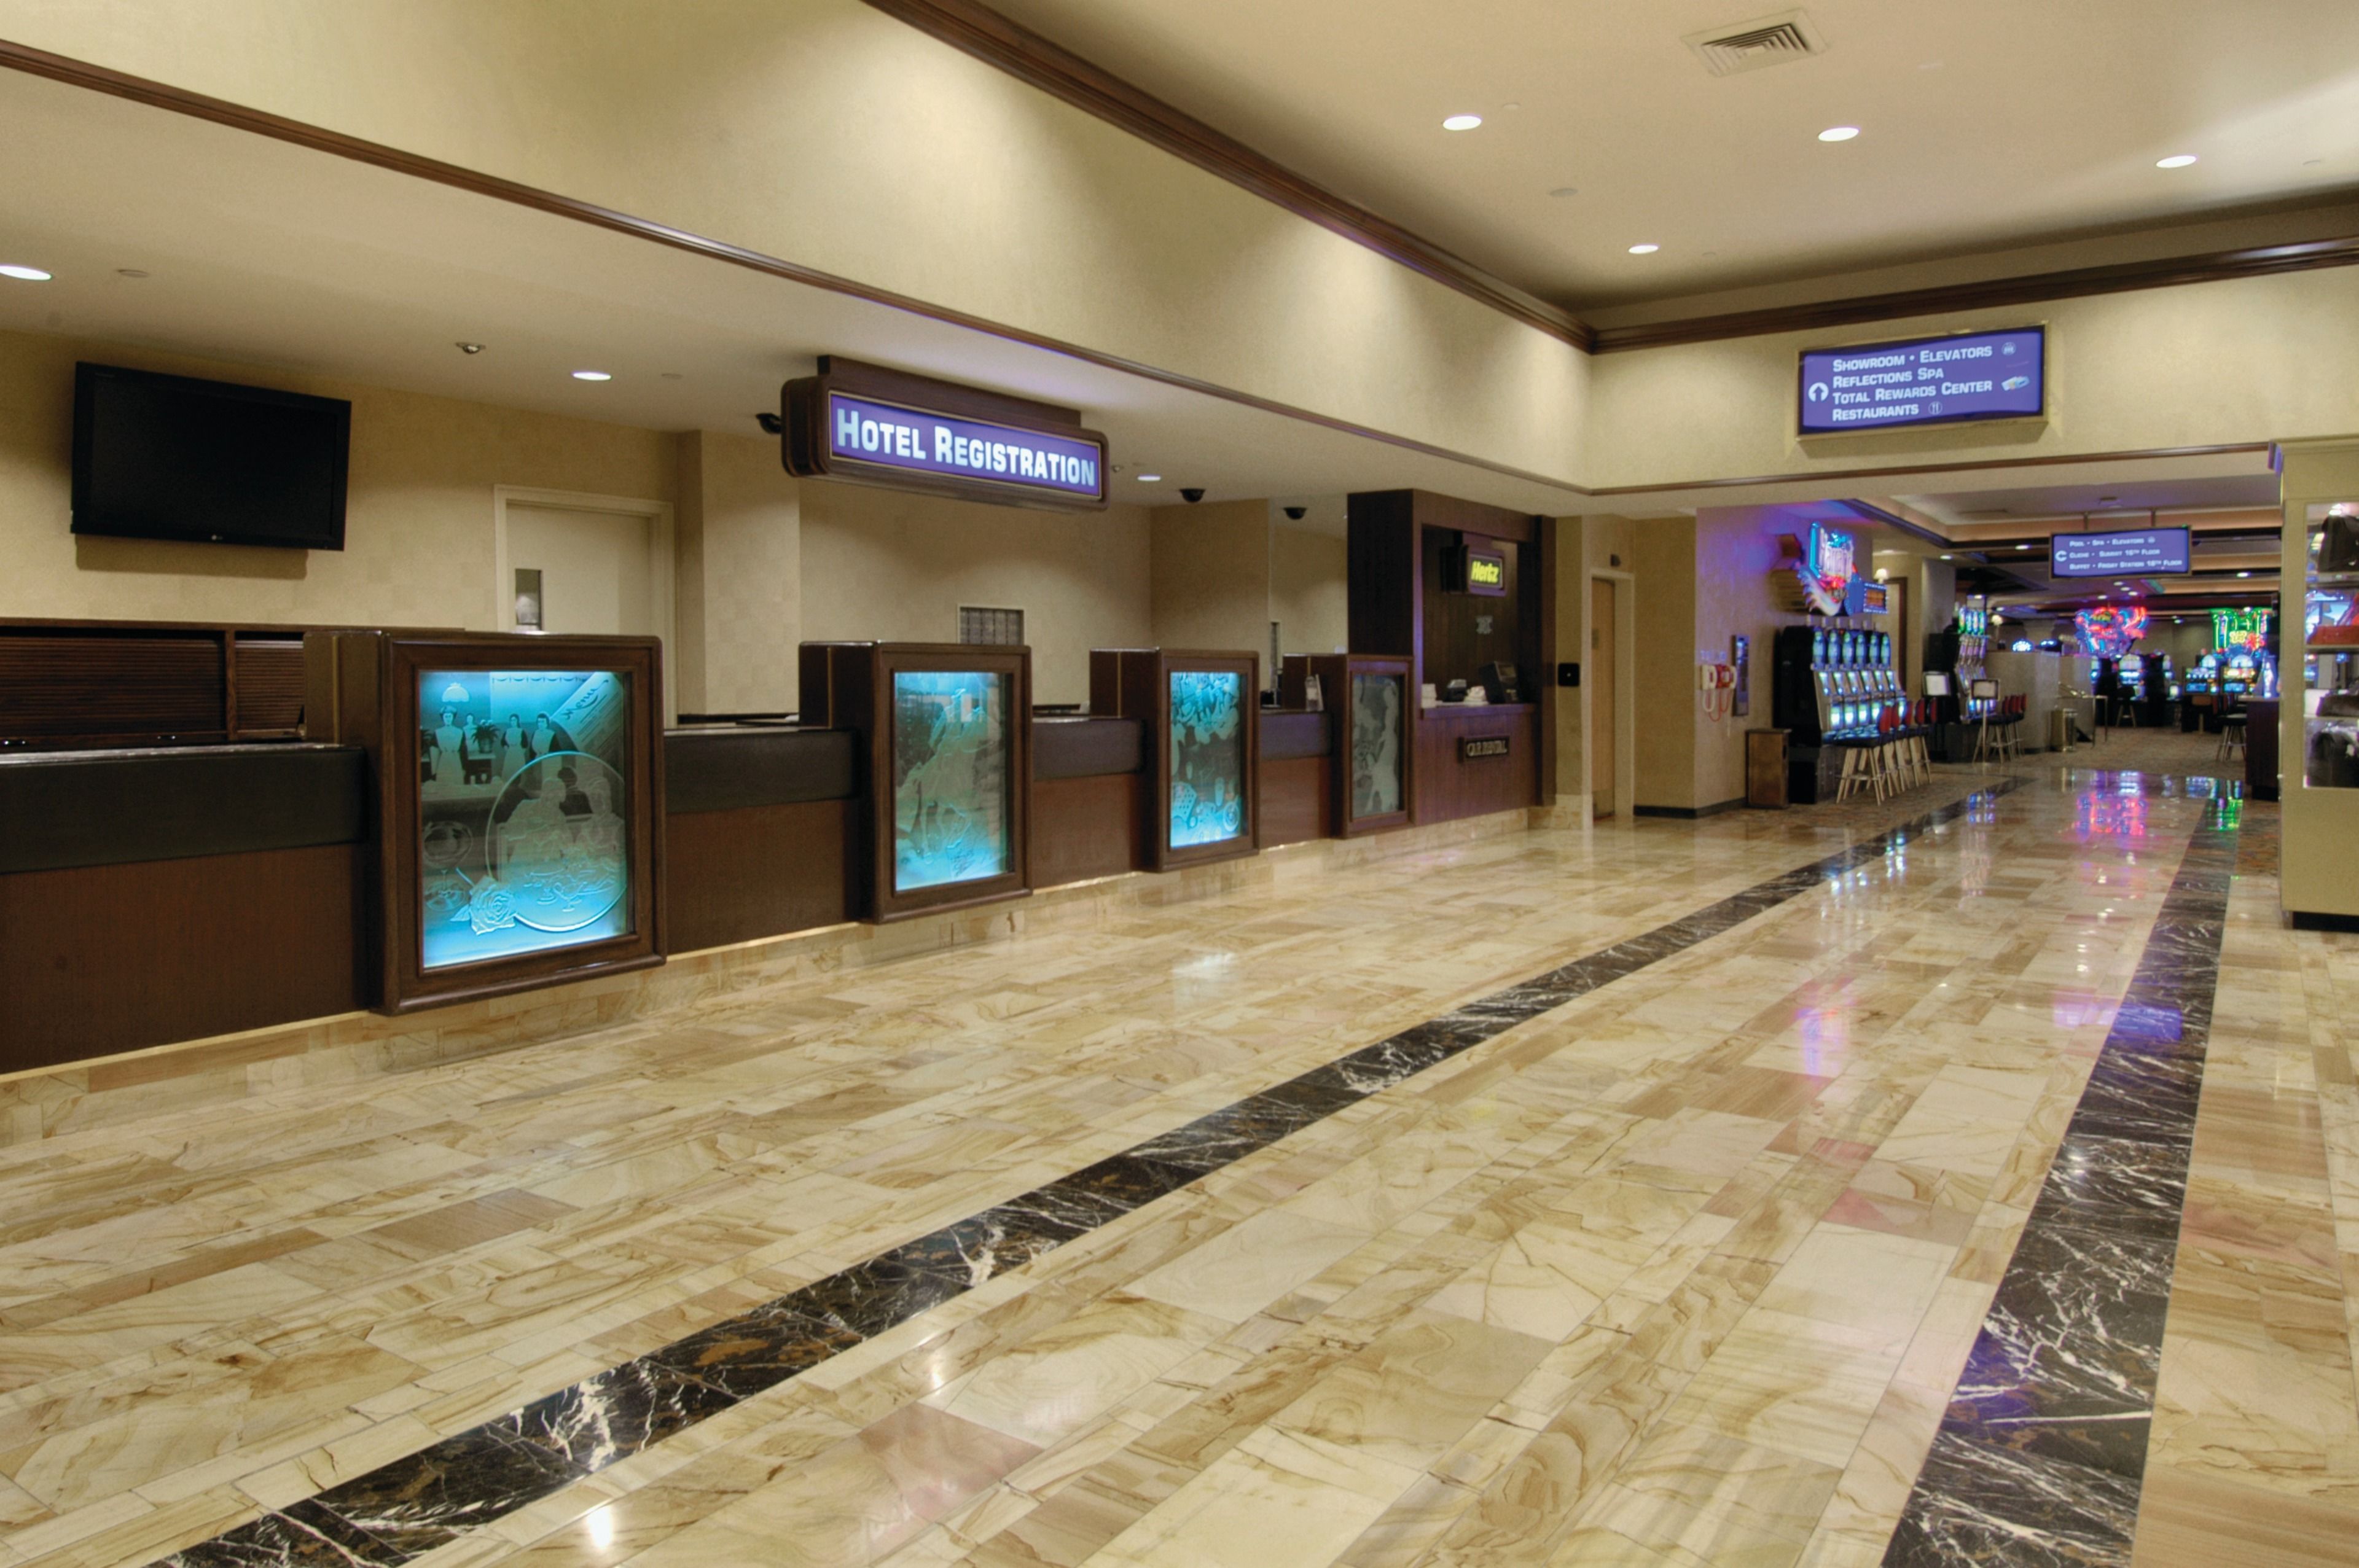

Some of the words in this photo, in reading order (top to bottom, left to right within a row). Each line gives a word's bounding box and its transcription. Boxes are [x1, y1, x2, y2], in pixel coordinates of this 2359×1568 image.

[1833, 354, 1905, 372] SHOWROOM
[1920, 346, 1993, 364] ELEVATORS
[1833, 371, 1913, 389] REFLECTIONS
[1917, 367, 1944, 381] SPA
[1833, 391, 1871, 405] TOTAL
[1875, 385, 1936, 402] REWARDS
[1941, 380, 1993, 396] CENTER
[1833, 404, 1919, 422] RESTAURANTS
[837, 408, 926, 460] HOTEL
[934, 425, 1095, 487] REGISTRATION
[1470, 560, 1499, 583] Hertz
